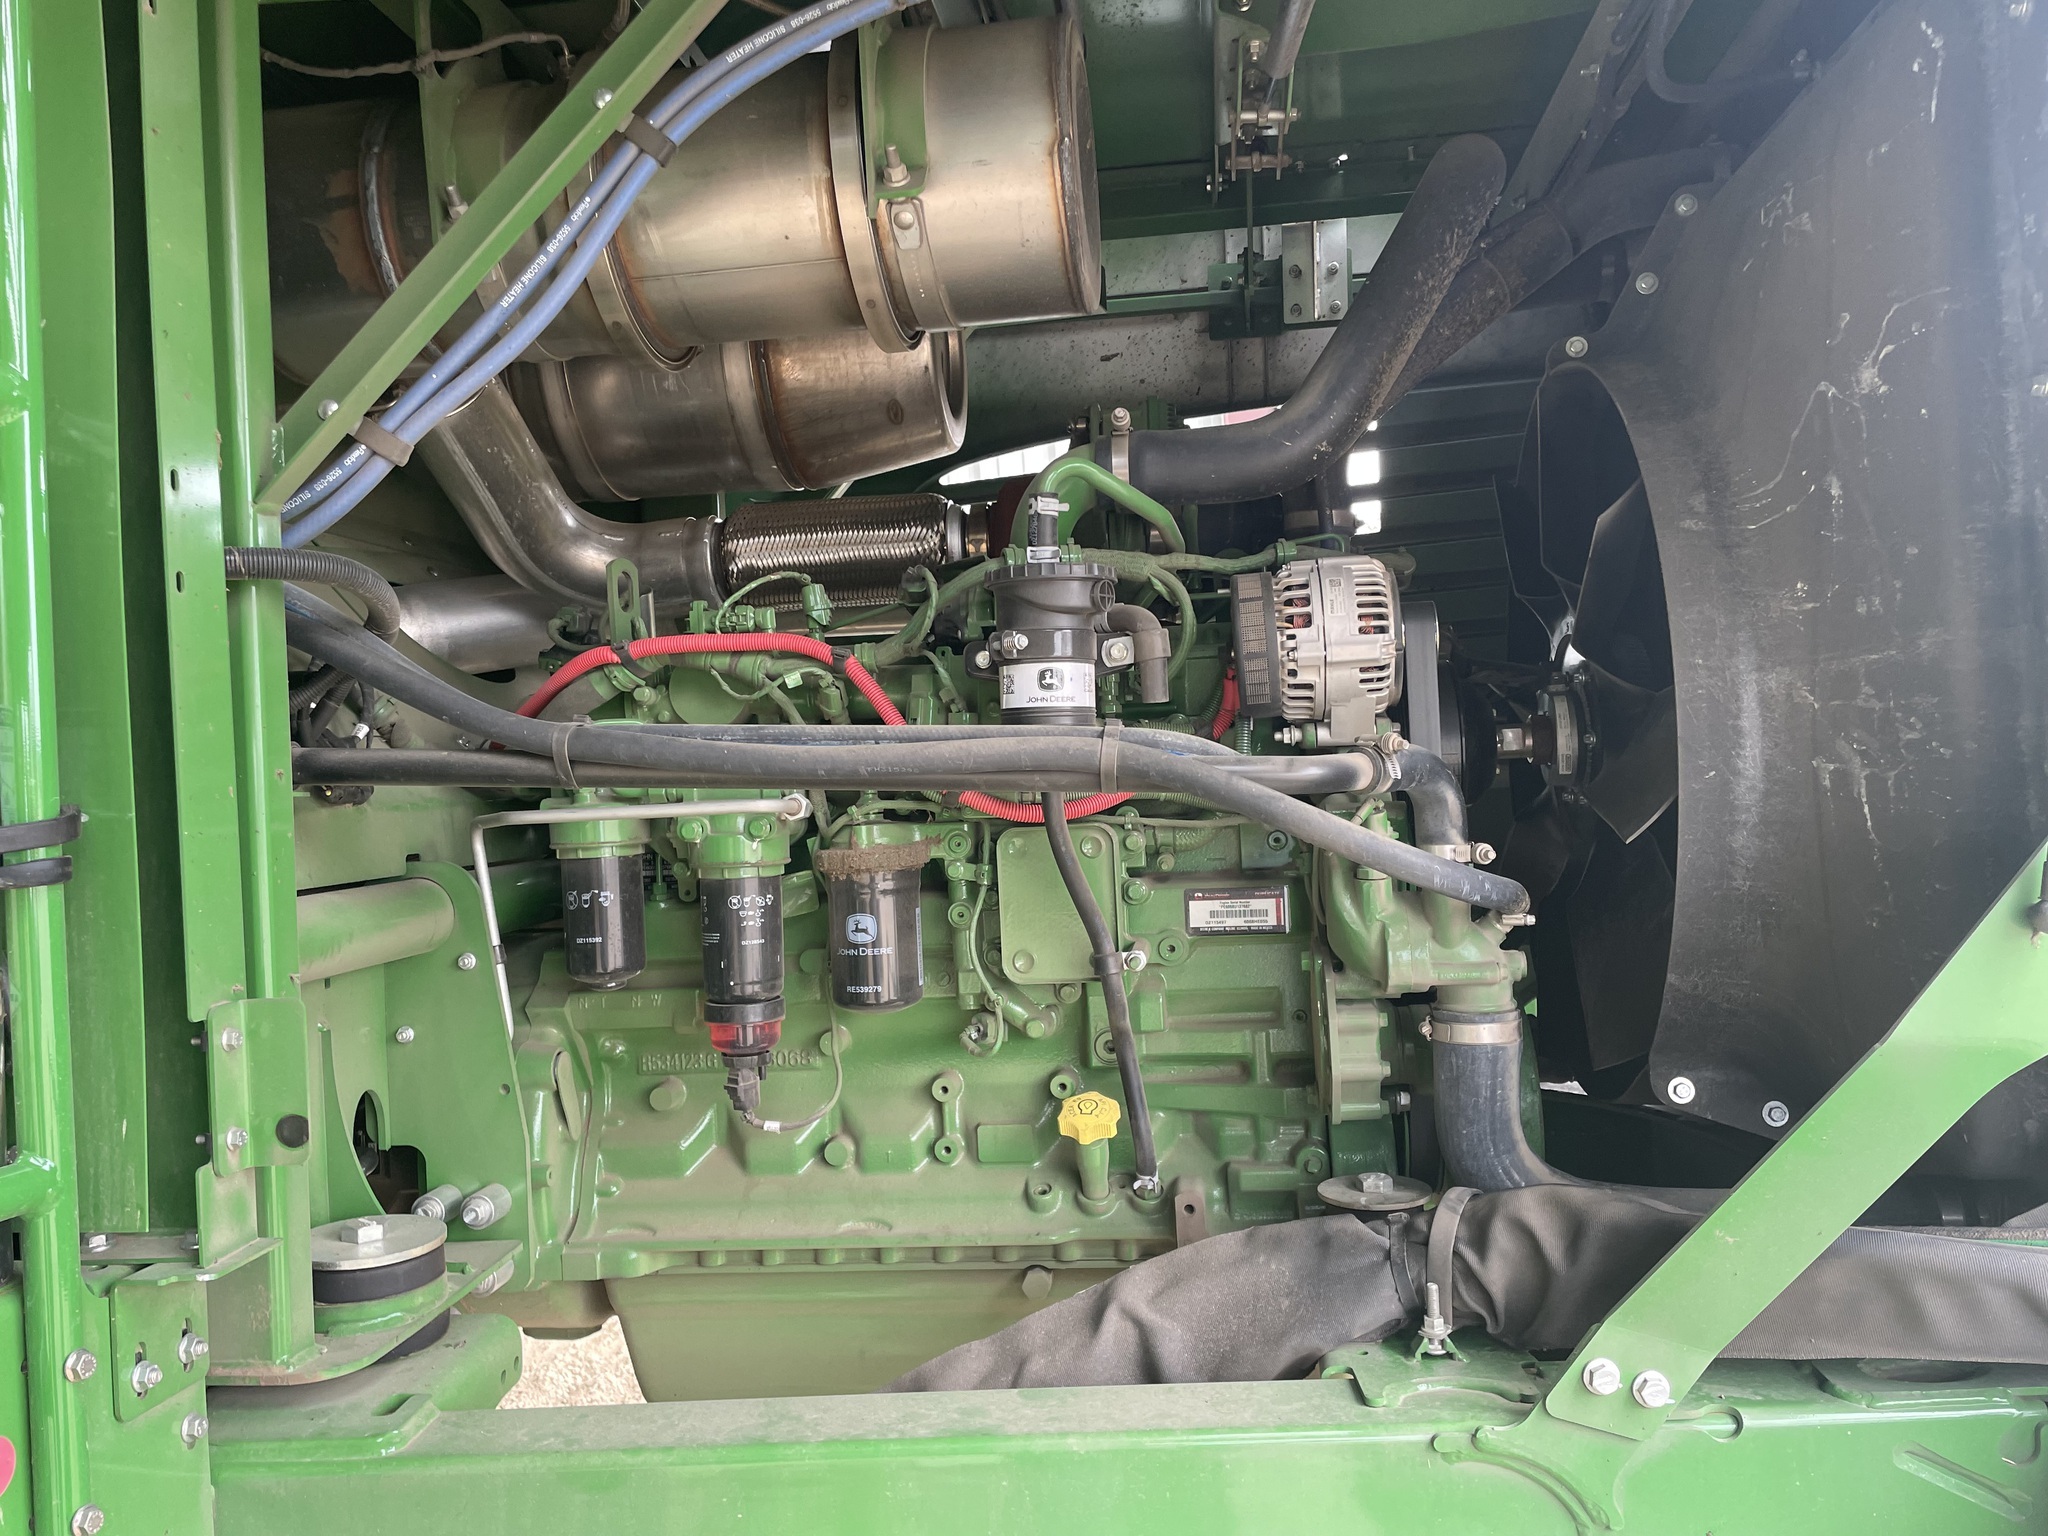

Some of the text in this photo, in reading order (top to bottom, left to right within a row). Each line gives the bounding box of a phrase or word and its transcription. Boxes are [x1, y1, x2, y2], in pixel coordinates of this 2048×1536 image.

[791, 9, 822, 28] 5526-038
[755, 24, 786, 43] SILICONE
[725, 38, 755, 63] HEATER
[547, 224, 571, 253] 5526-038
[521, 254, 547, 284] SILICONE
[500, 281, 524, 308] HEATER
[314, 467, 343, 491] 5526-038
[1026, 695, 1076, 704] JOHN DEERE
[837, 946, 894, 956] JOHN DEERE
[846, 985, 882, 993] RE539279
